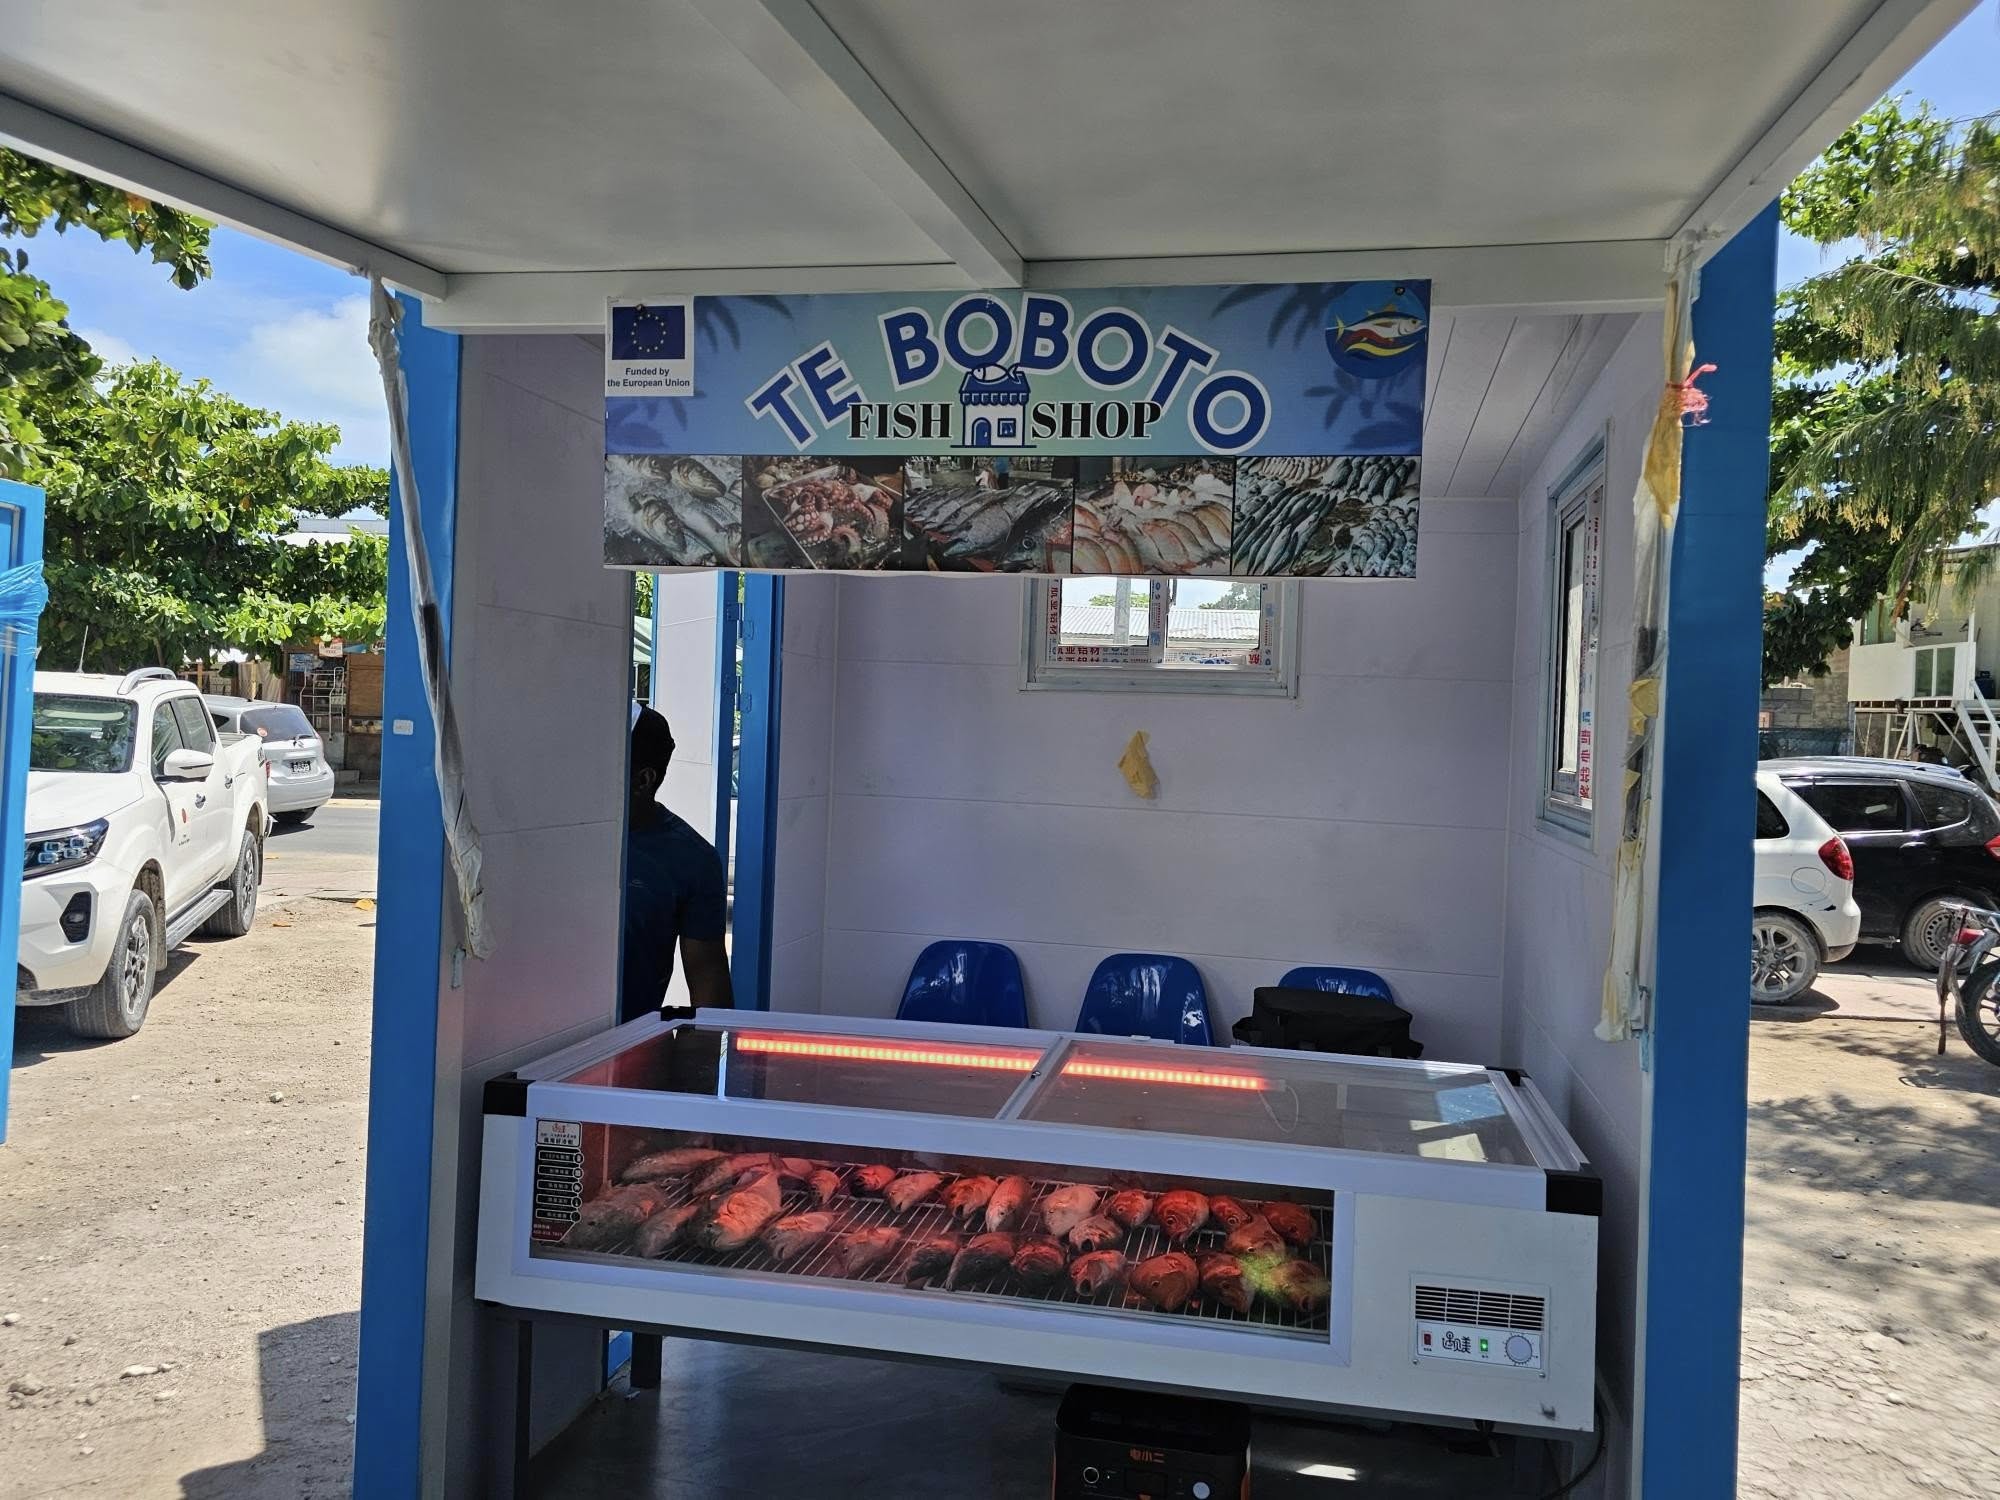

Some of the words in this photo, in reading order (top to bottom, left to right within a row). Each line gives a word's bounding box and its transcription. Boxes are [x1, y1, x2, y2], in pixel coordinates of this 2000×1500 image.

[607, 379, 620, 387] the
[622, 379, 663, 389] European
[665, 378, 690, 387] Union
[625, 367, 657, 376] Funded
[659, 367, 670, 377] by
[747, 342, 867, 449] TE
[880, 293, 1270, 454] BOBOTO
[848, 403, 952, 439] FISH
[1031, 402, 1161, 439] SHOP
